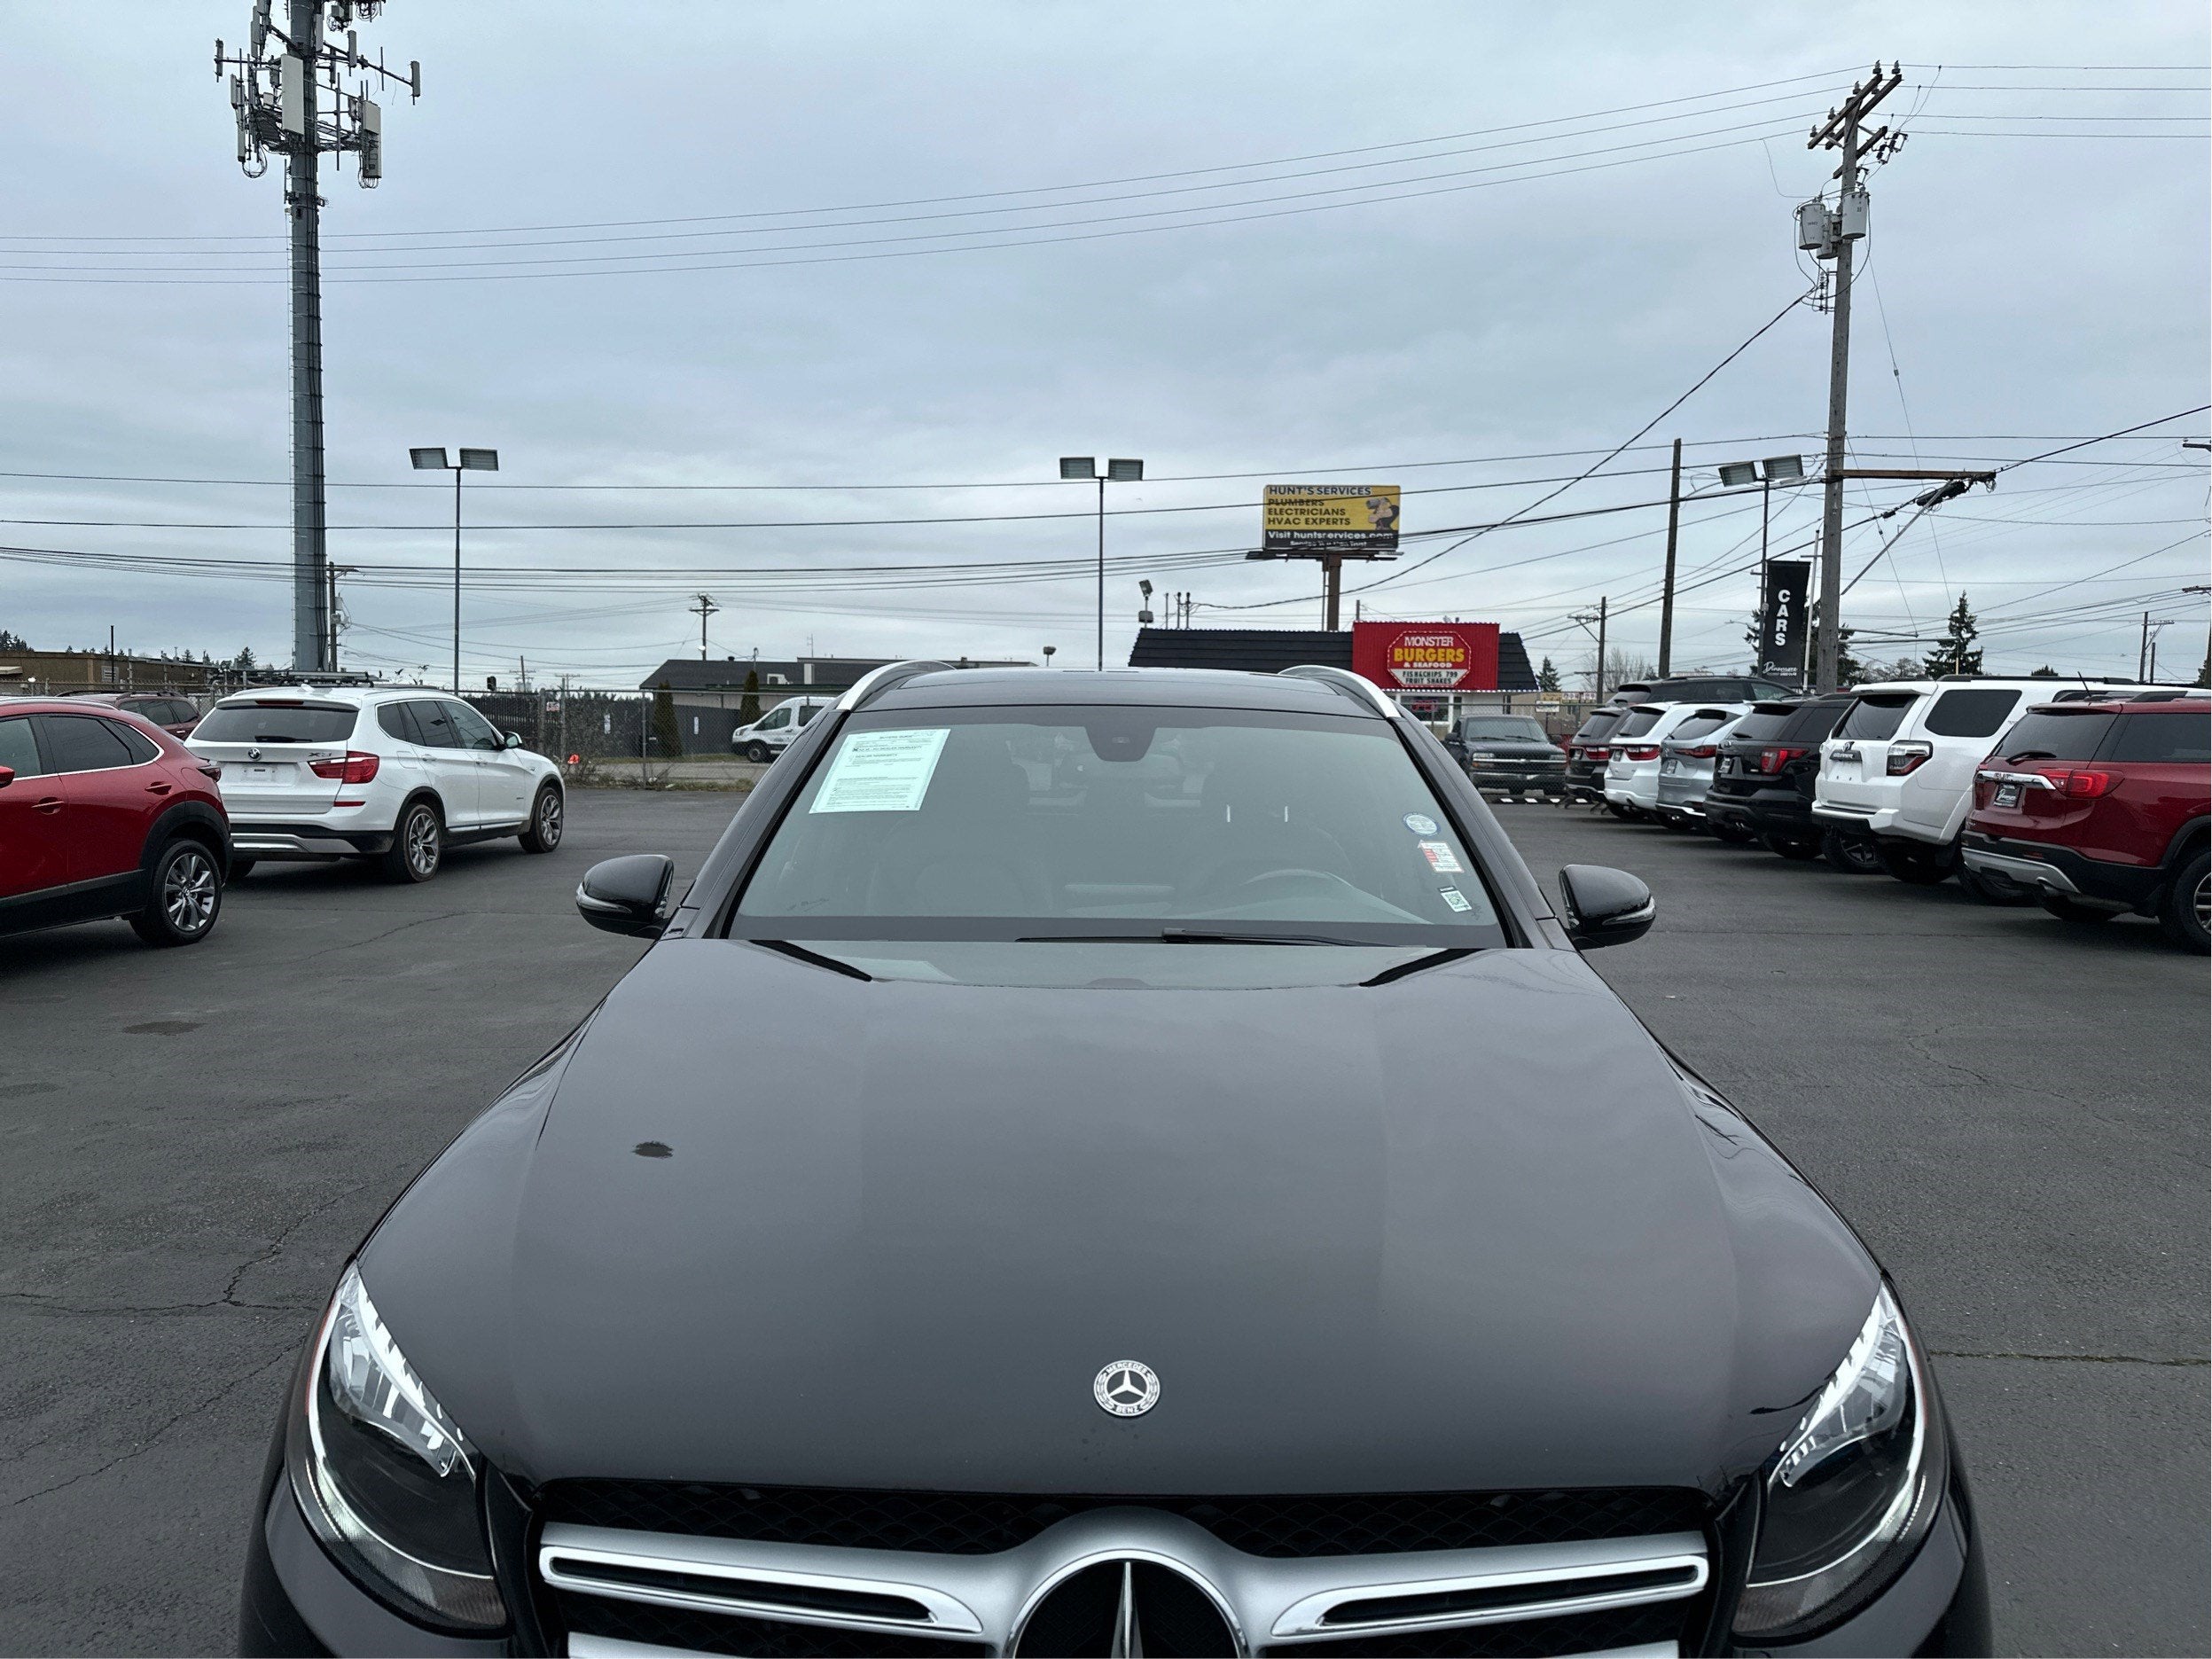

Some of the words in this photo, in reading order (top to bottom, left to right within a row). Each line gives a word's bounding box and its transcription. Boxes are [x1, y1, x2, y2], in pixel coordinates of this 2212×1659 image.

[1774, 589, 1791, 646] CARS
[1404, 636, 1454, 646] MONSTER
[1394, 647, 1465, 662] BURGERS
[1106, 1362, 1147, 1373] MERCEDES
[1115, 1405, 1140, 1414] BENZ
